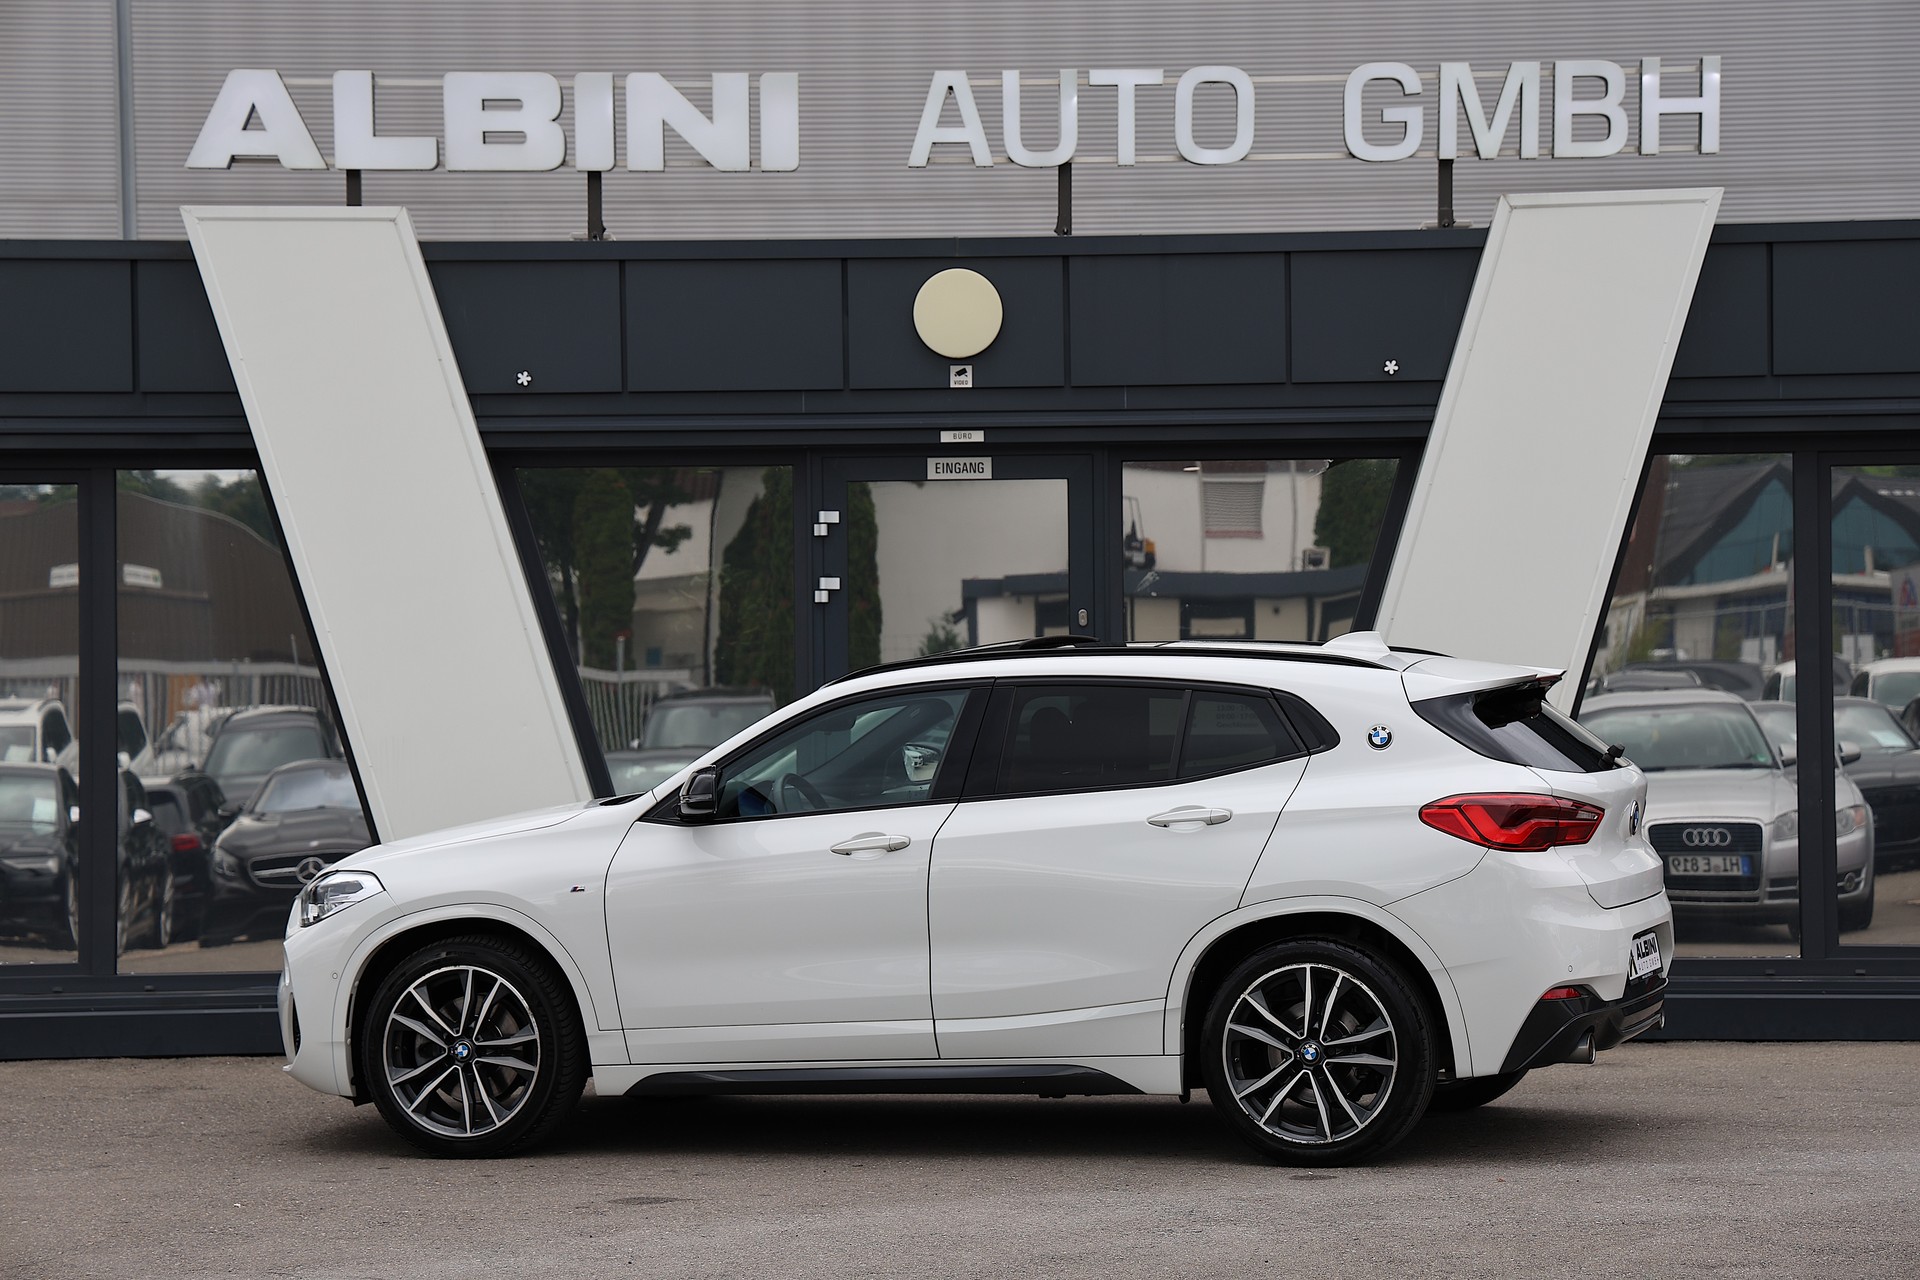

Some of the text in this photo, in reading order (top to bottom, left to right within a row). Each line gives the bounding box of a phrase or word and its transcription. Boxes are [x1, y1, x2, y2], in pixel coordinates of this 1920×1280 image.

[184, 55, 1721, 172] ALBINI AUTO GMBH
[952, 431, 973, 440] BÜRO
[935, 461, 985, 474] EINGANG
[1636, 936, 1658, 960] ALBINI
